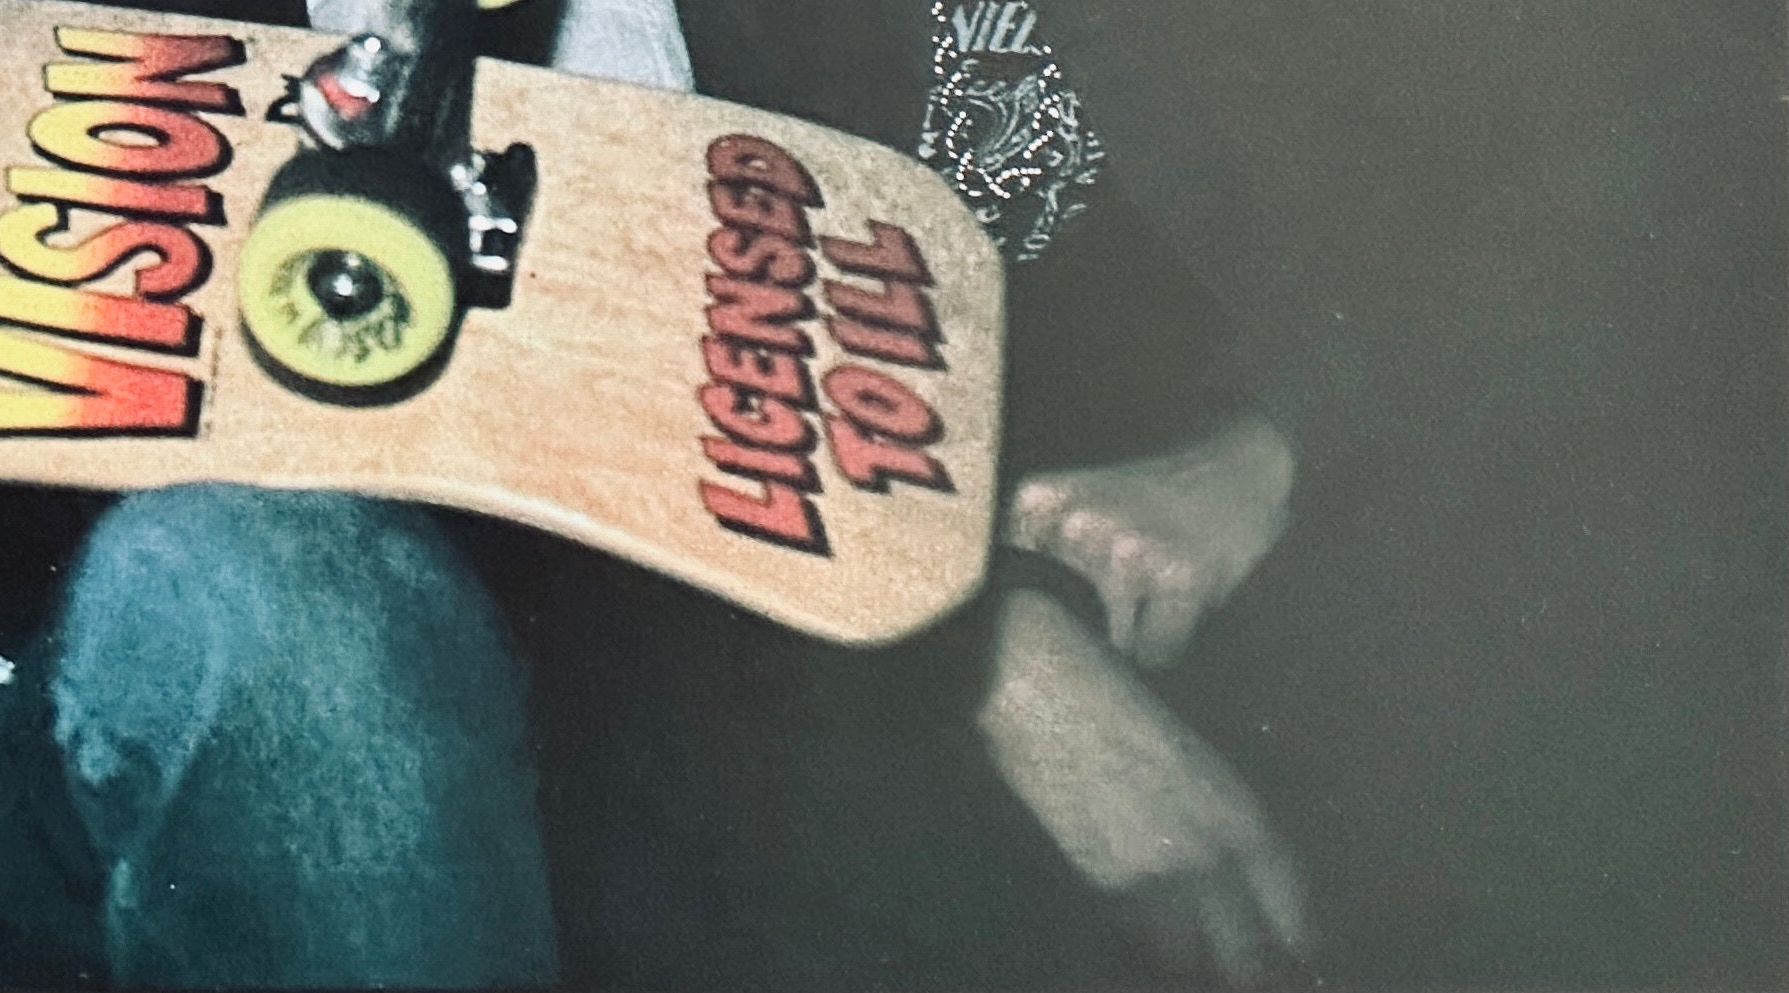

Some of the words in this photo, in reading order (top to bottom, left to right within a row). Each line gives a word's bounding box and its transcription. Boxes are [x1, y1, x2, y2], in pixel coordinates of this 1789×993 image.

[698, 133, 834, 558] LICENSED
[818, 218, 948, 371] ILL
[818, 363, 958, 494] TO
